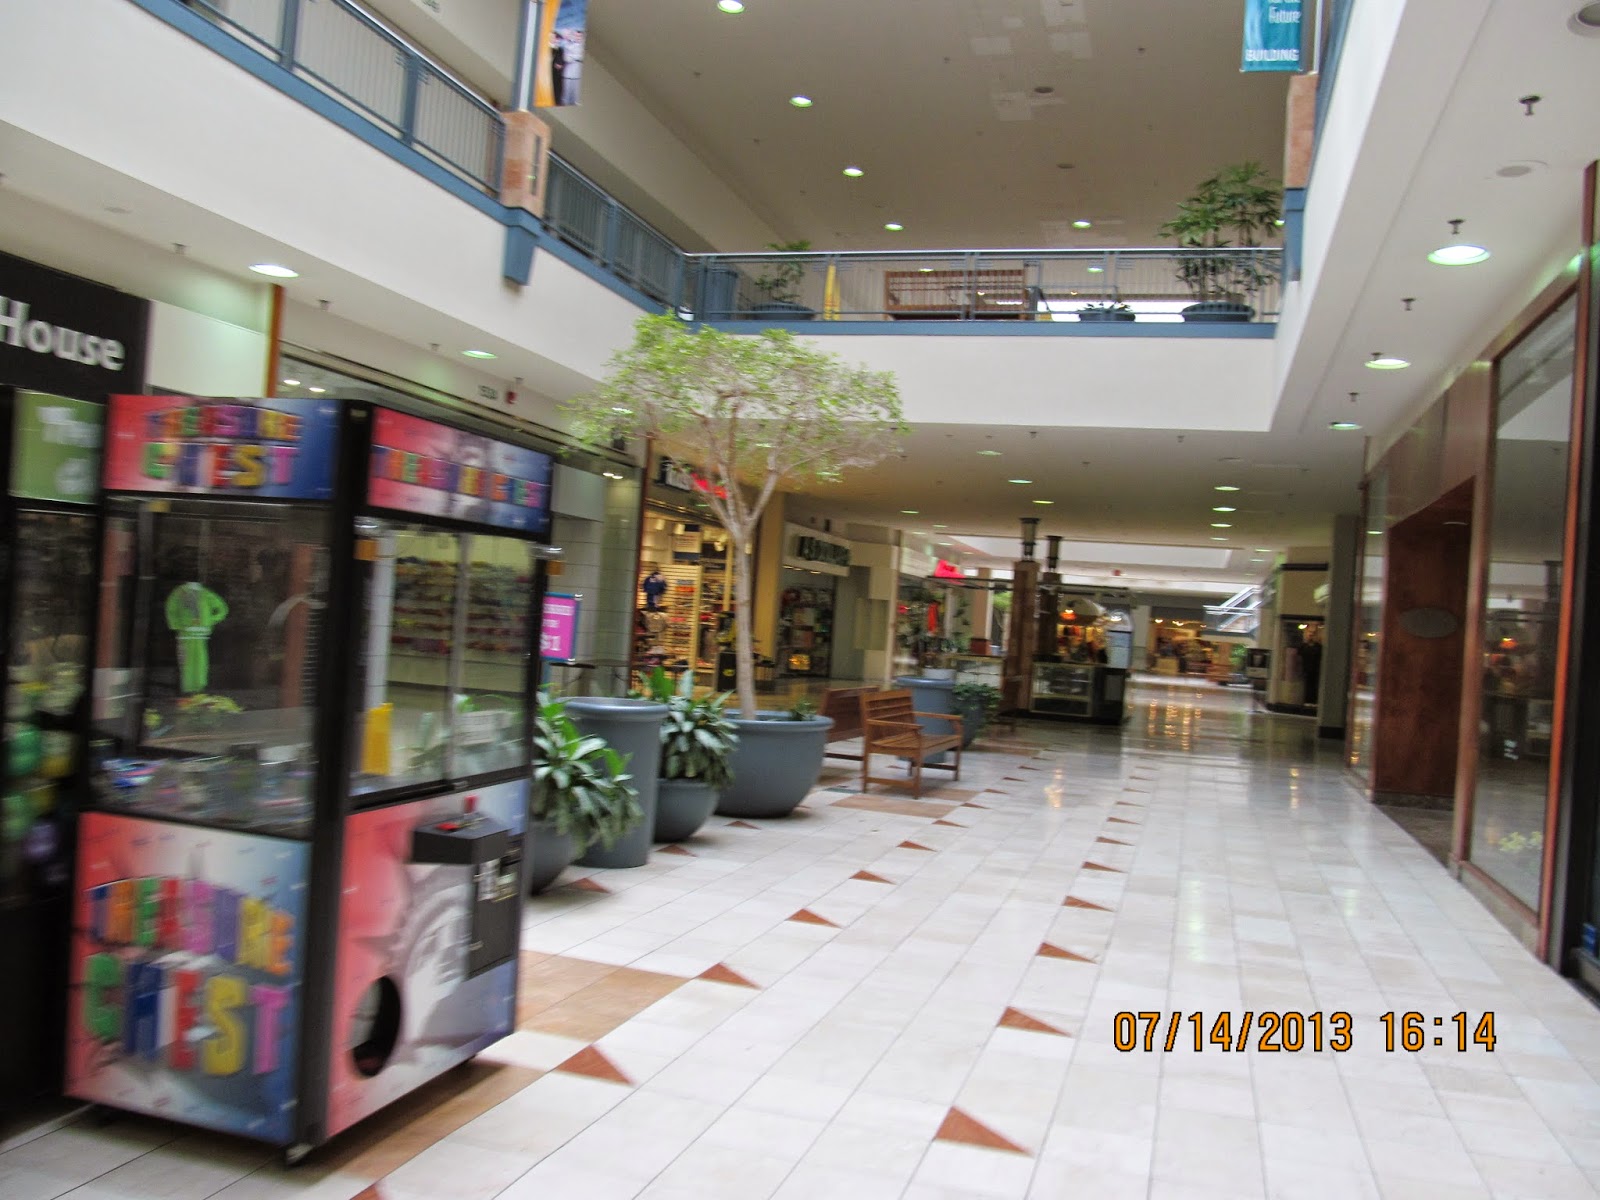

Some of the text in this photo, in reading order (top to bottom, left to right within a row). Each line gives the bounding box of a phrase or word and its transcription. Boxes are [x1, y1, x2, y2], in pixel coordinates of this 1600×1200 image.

[1268, 7, 1301, 24] Future
[1245, 49, 1300, 62] BUILDING
[0, 295, 126, 372] House
[142, 442, 300, 487] CHEST
[83, 952, 292, 1077] CHEST
